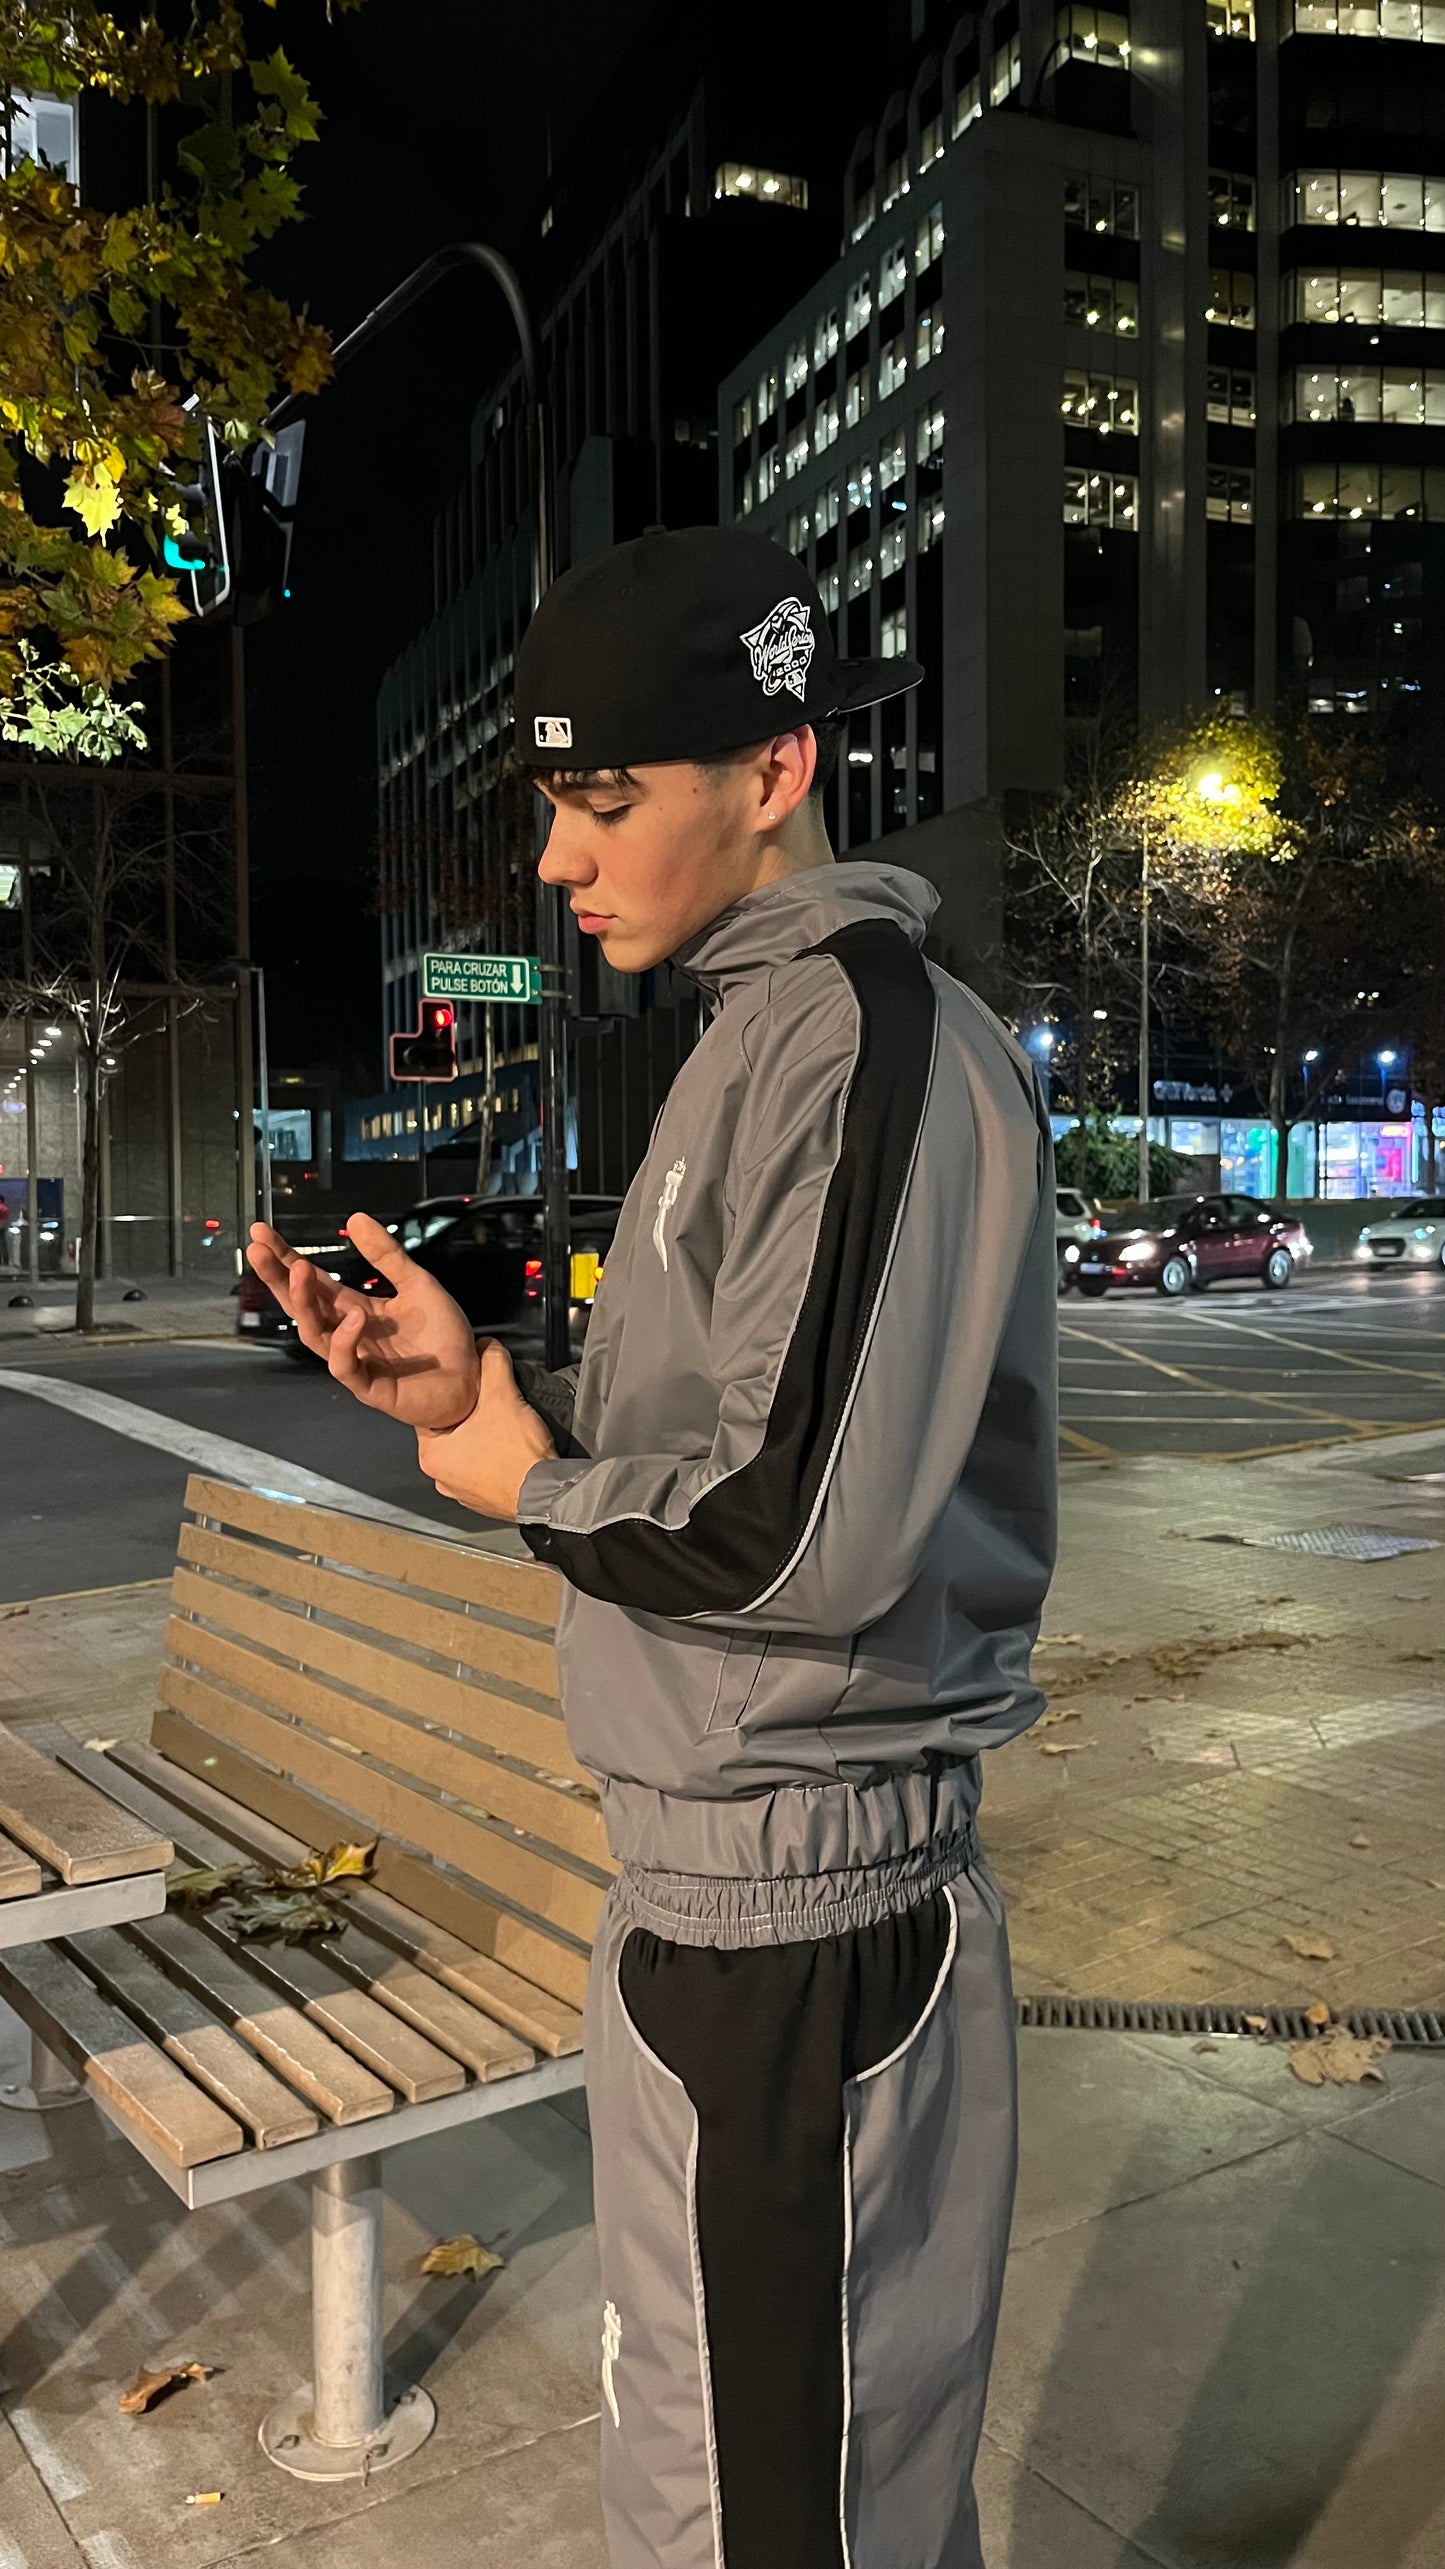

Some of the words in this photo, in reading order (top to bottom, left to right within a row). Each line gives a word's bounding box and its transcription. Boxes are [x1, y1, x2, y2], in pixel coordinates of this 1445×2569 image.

[755, 631, 790, 675] World
[776, 656, 807, 676] 2000
[431, 960, 462, 975] PARA
[463, 962, 507, 977] CRUZAR
[431, 977, 468, 992] PULSE
[470, 978, 509, 994] BOTÓN
